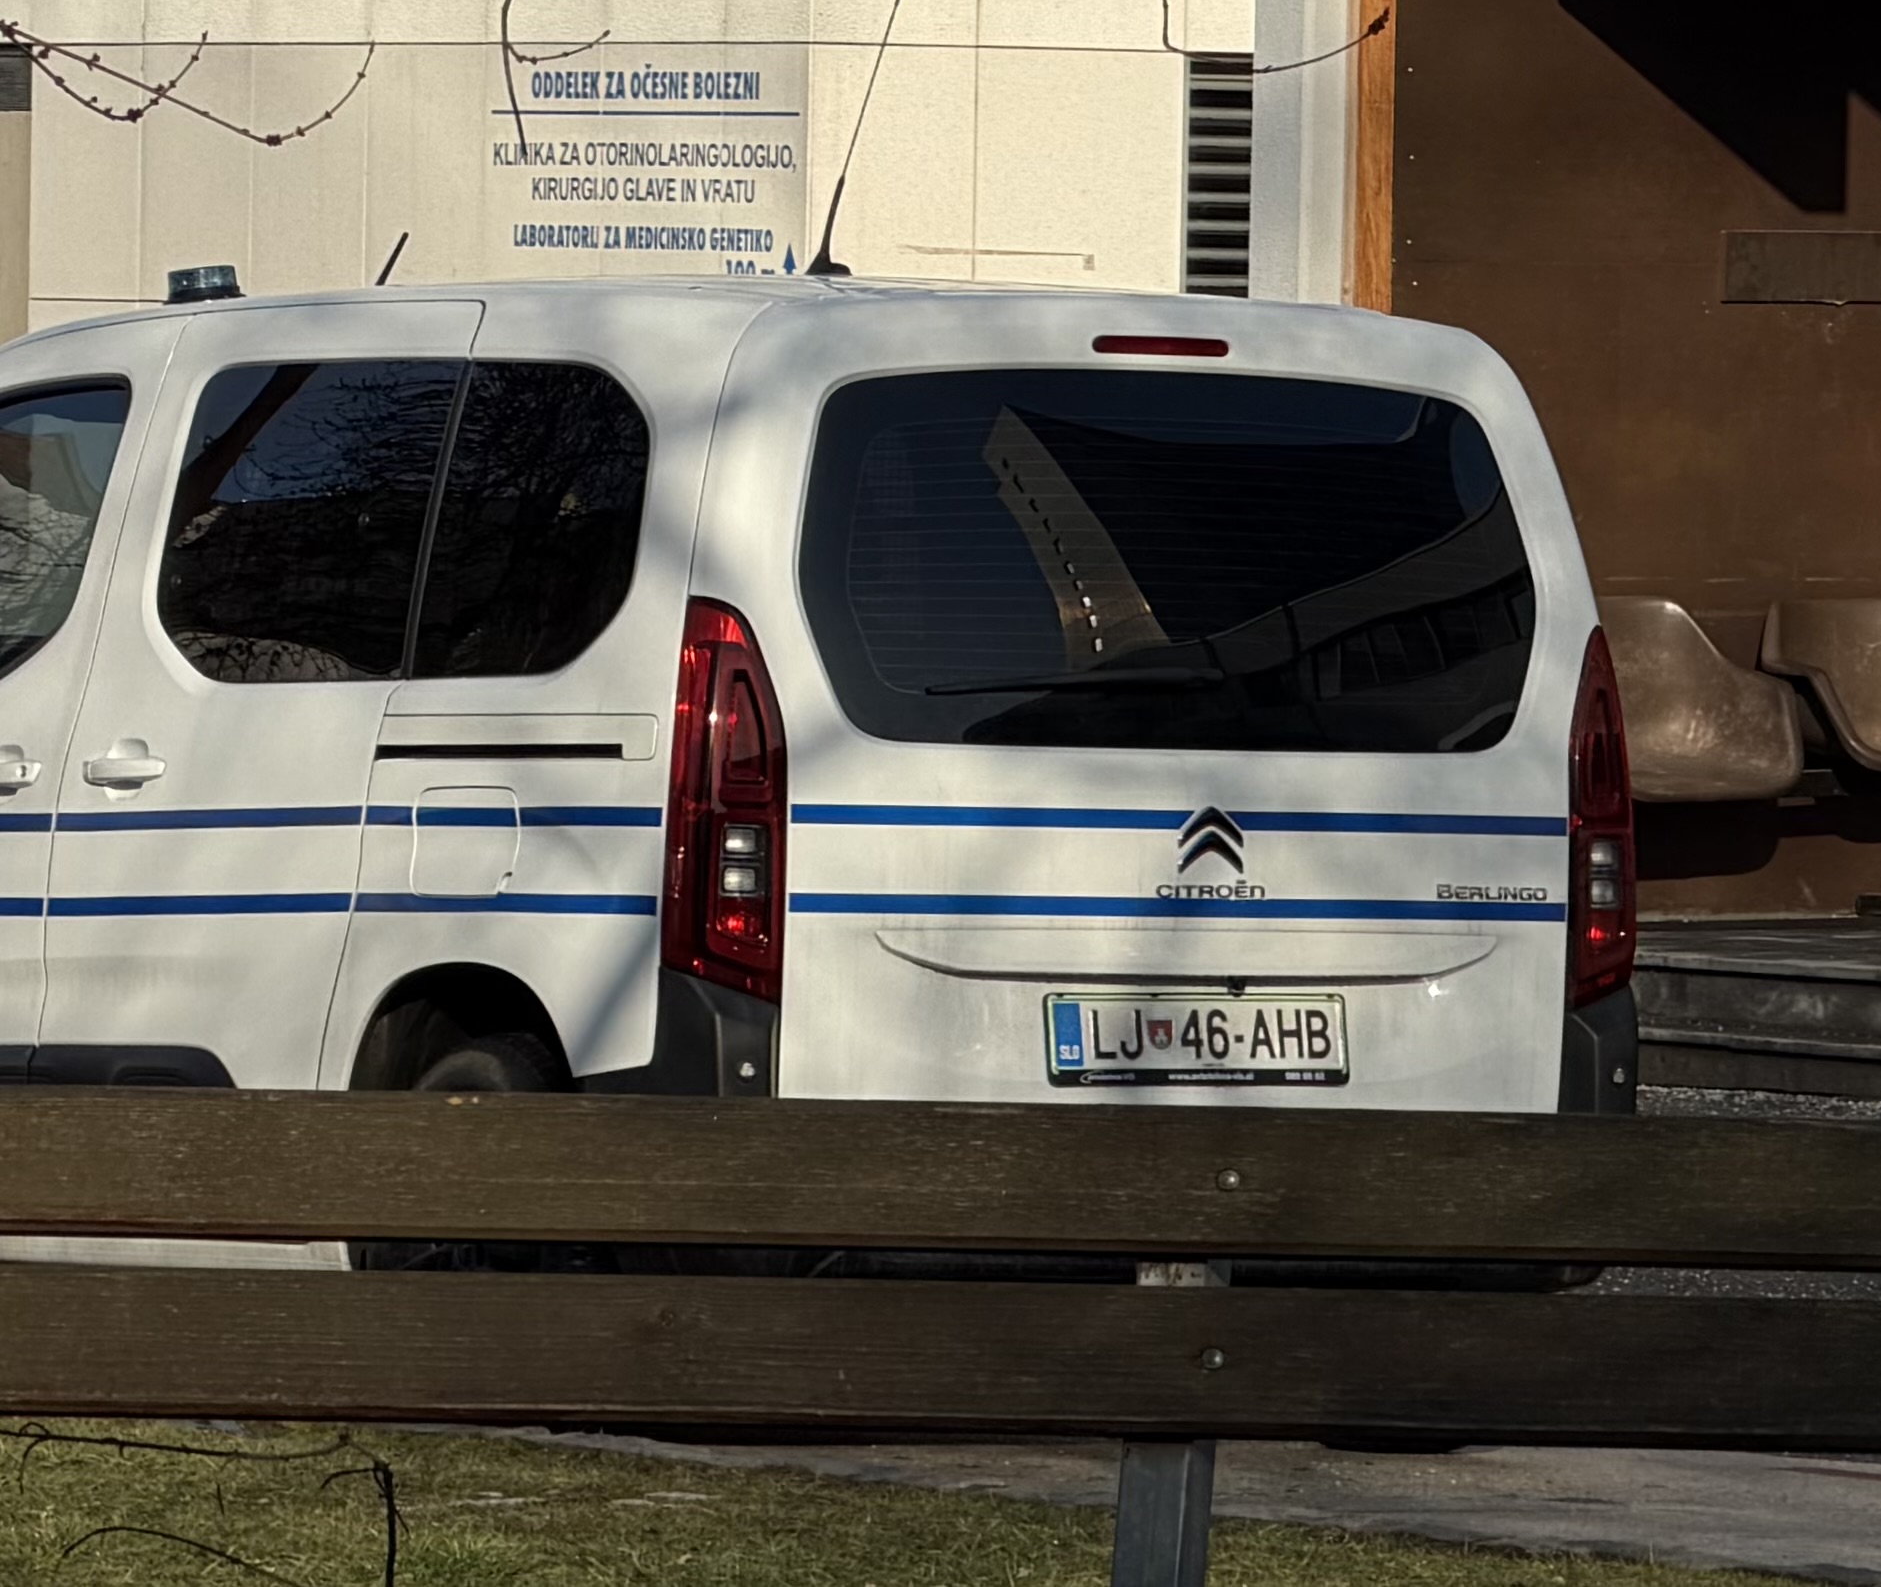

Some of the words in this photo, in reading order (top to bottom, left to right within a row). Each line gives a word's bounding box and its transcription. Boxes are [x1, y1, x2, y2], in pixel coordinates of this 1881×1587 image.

[531, 71, 600, 99] ODDELEK
[605, 72, 625, 99] ZA
[630, 63, 688, 100] OČESNE
[693, 71, 760, 100] BOLEZNI
[493, 142, 556, 166] KLINIKA
[559, 143, 580, 166] ZA
[584, 143, 797, 173] OTORINOLARINGOLOGIJO,
[532, 177, 618, 201] KIRURGIJO
[623, 178, 676, 202] GLAVE
[681, 179, 696, 202] IN
[701, 179, 755, 203] VRATU
[603, 225, 621, 249] ZA
[625, 226, 706, 251] MEDICINSKO
[710, 228, 773, 252] GENETIKO
[1437, 883, 1547, 902] BERLINGO
[1059, 1044, 1080, 1060] SLO
[1091, 1008, 1145, 1061] LJ
[1180, 1009, 1332, 1061] 46-AHB
